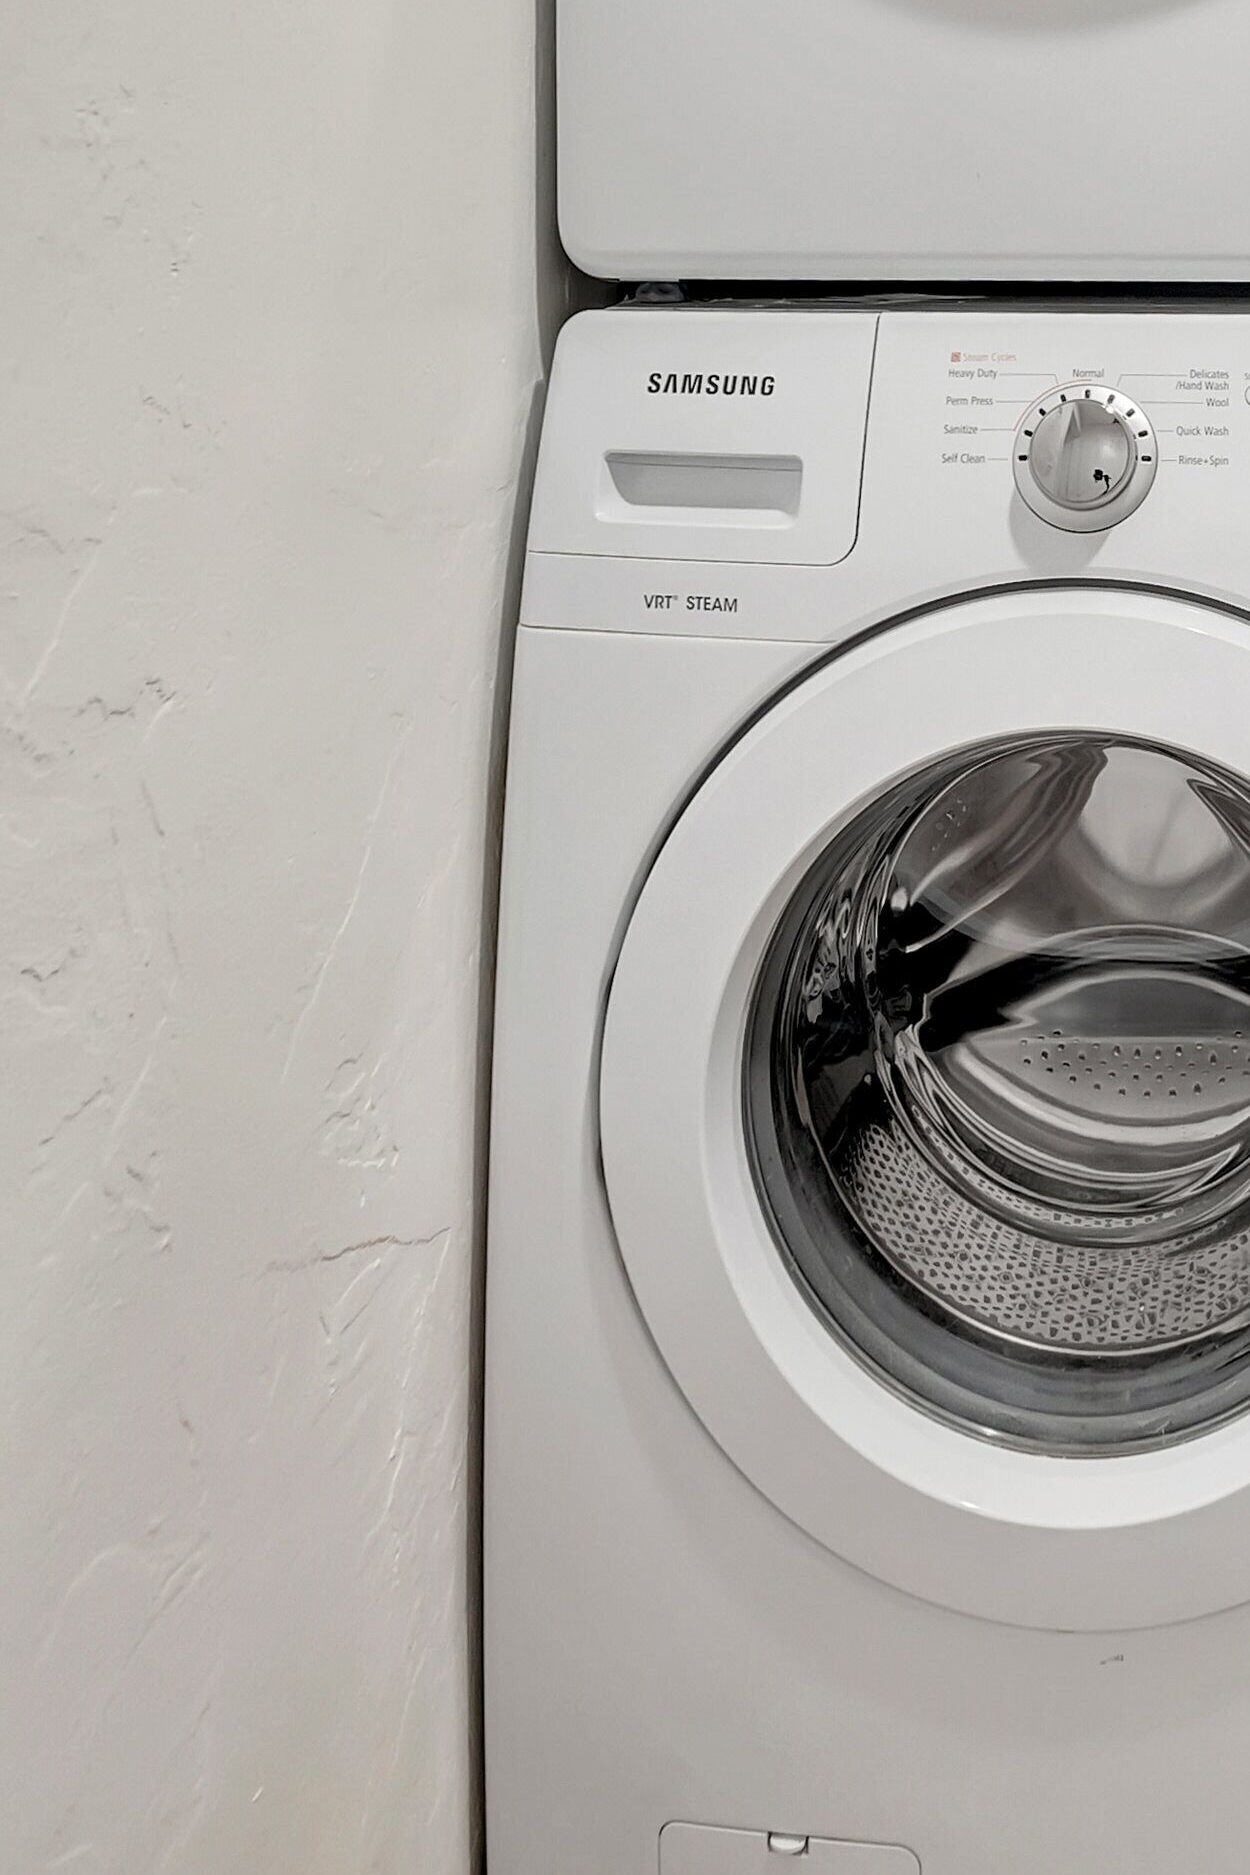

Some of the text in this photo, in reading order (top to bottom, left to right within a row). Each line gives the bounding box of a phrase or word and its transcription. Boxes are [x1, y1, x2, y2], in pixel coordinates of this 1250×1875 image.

[991, 352, 1017, 363] Cycles
[948, 368, 998, 380] Heavy Duty
[1073, 368, 1105, 378] Normal
[1190, 368, 1229, 379] Delicates
[647, 372, 776, 396] SAMSUNG
[1204, 380, 1229, 391] Wash
[946, 395, 994, 406] Perm Press
[1206, 397, 1229, 407] Wool
[943, 423, 978, 435] Sanitize
[1176, 425, 1229, 437] Quick Wash
[941, 452, 986, 464] Self Clean
[686, 595, 739, 613] STEAM
